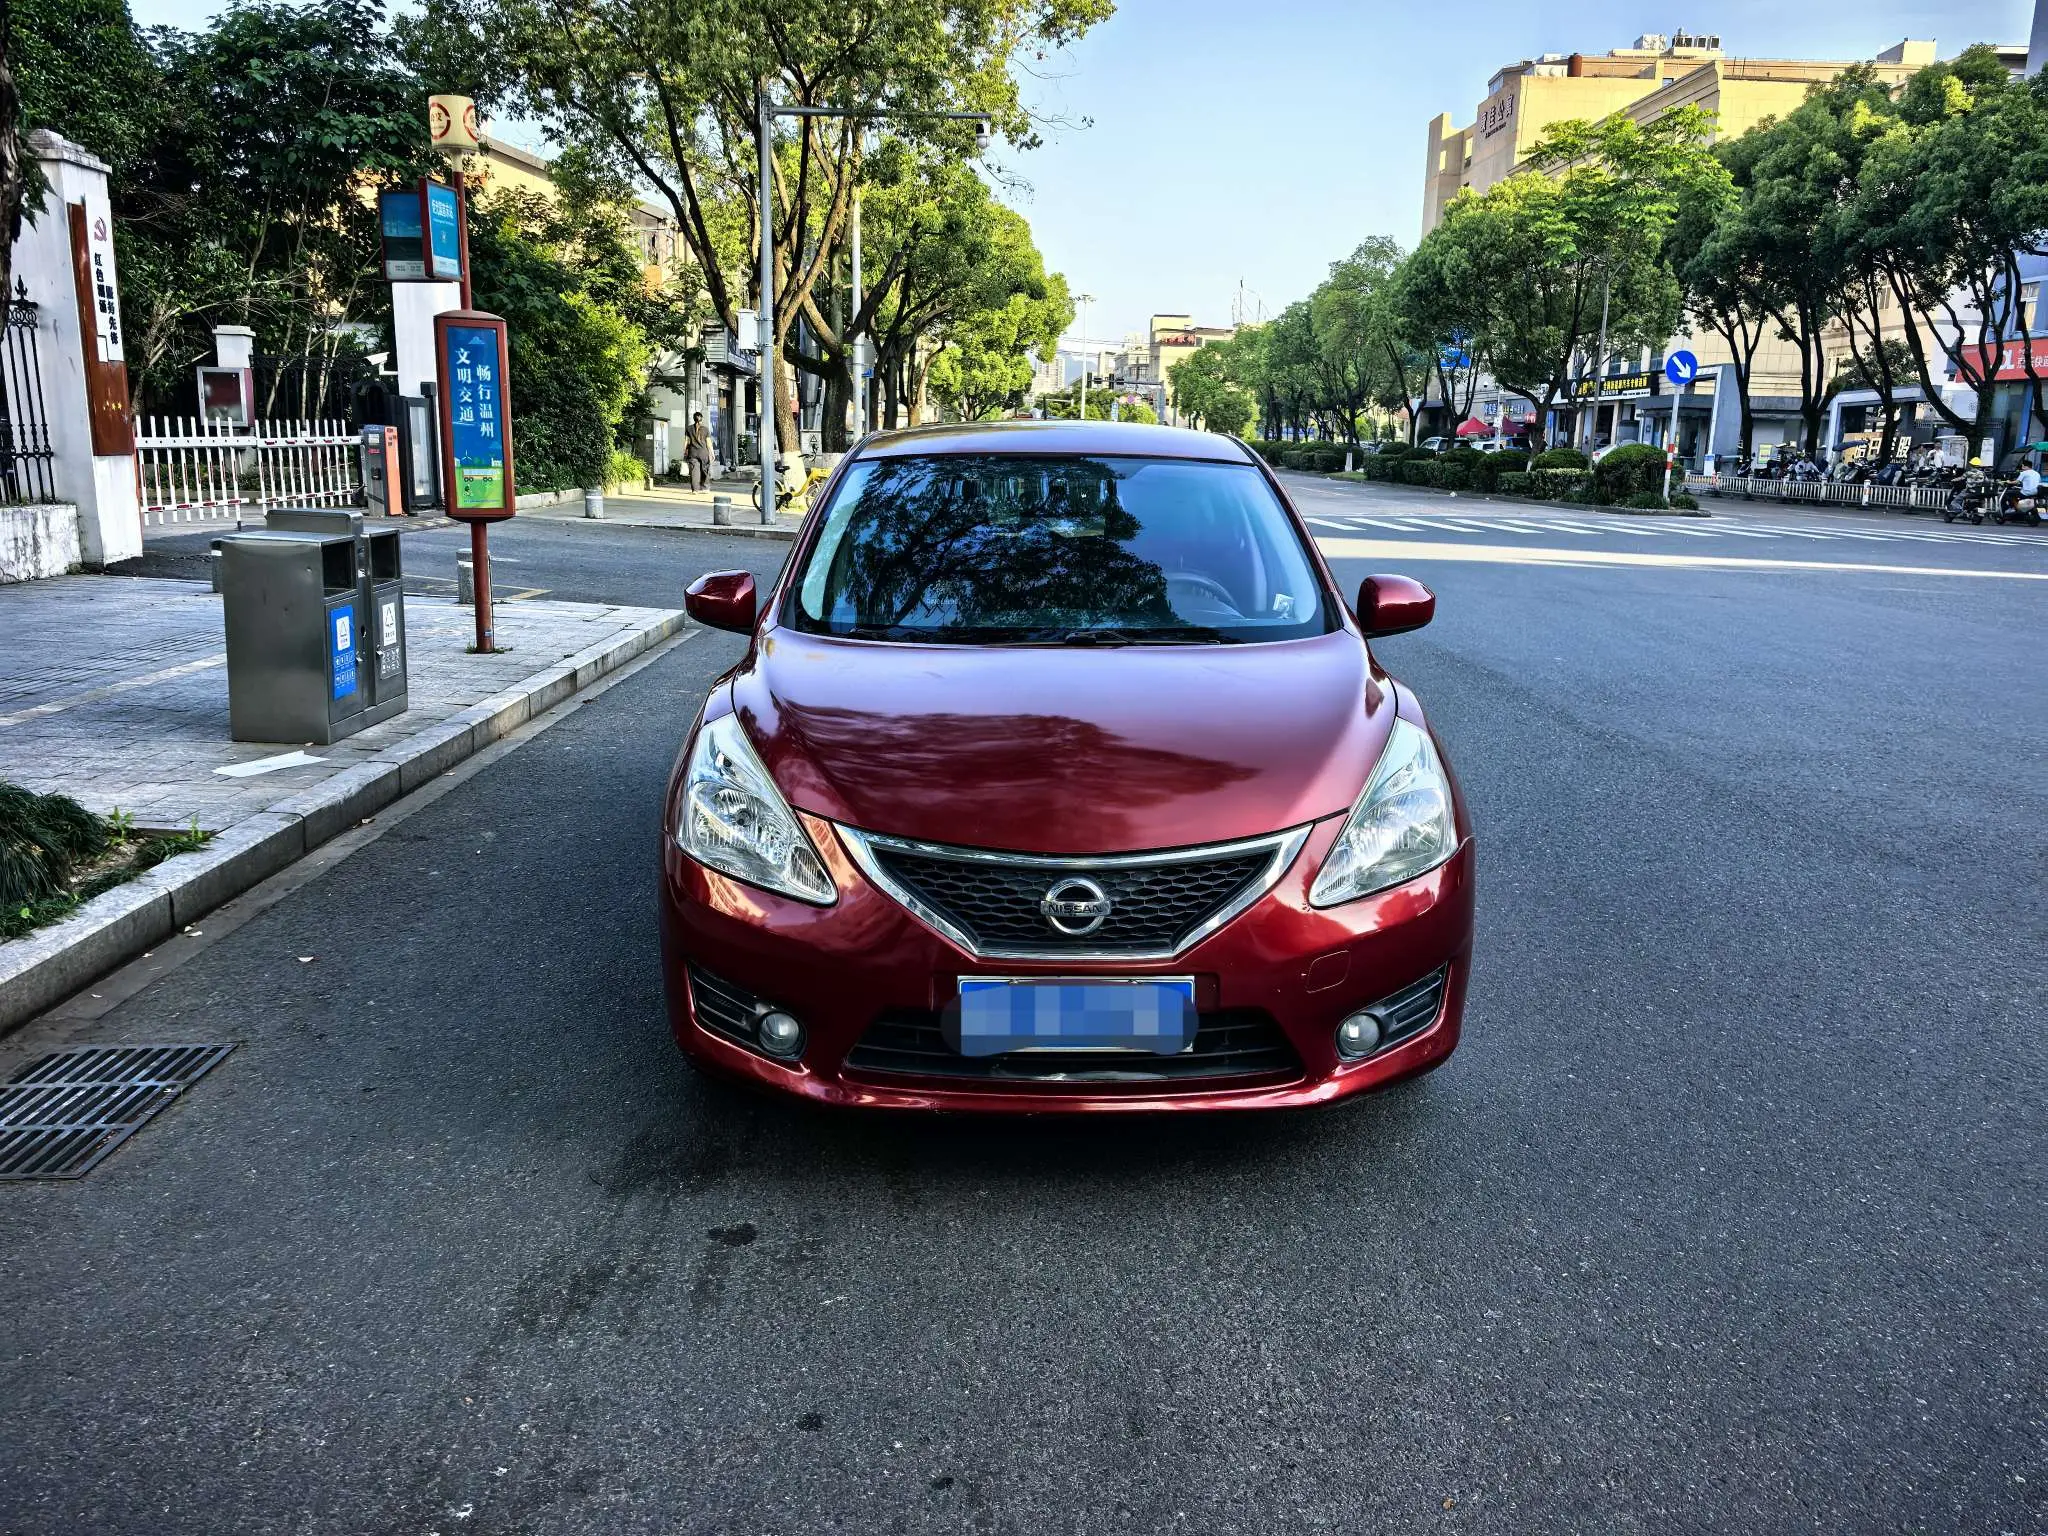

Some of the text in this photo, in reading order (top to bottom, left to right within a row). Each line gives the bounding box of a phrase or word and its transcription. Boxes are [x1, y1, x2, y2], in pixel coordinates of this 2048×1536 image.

[455, 347, 475, 422] 文明交通
[476, 363, 494, 438] 畅行温州
[1048, 903, 1102, 914] NISSAN
